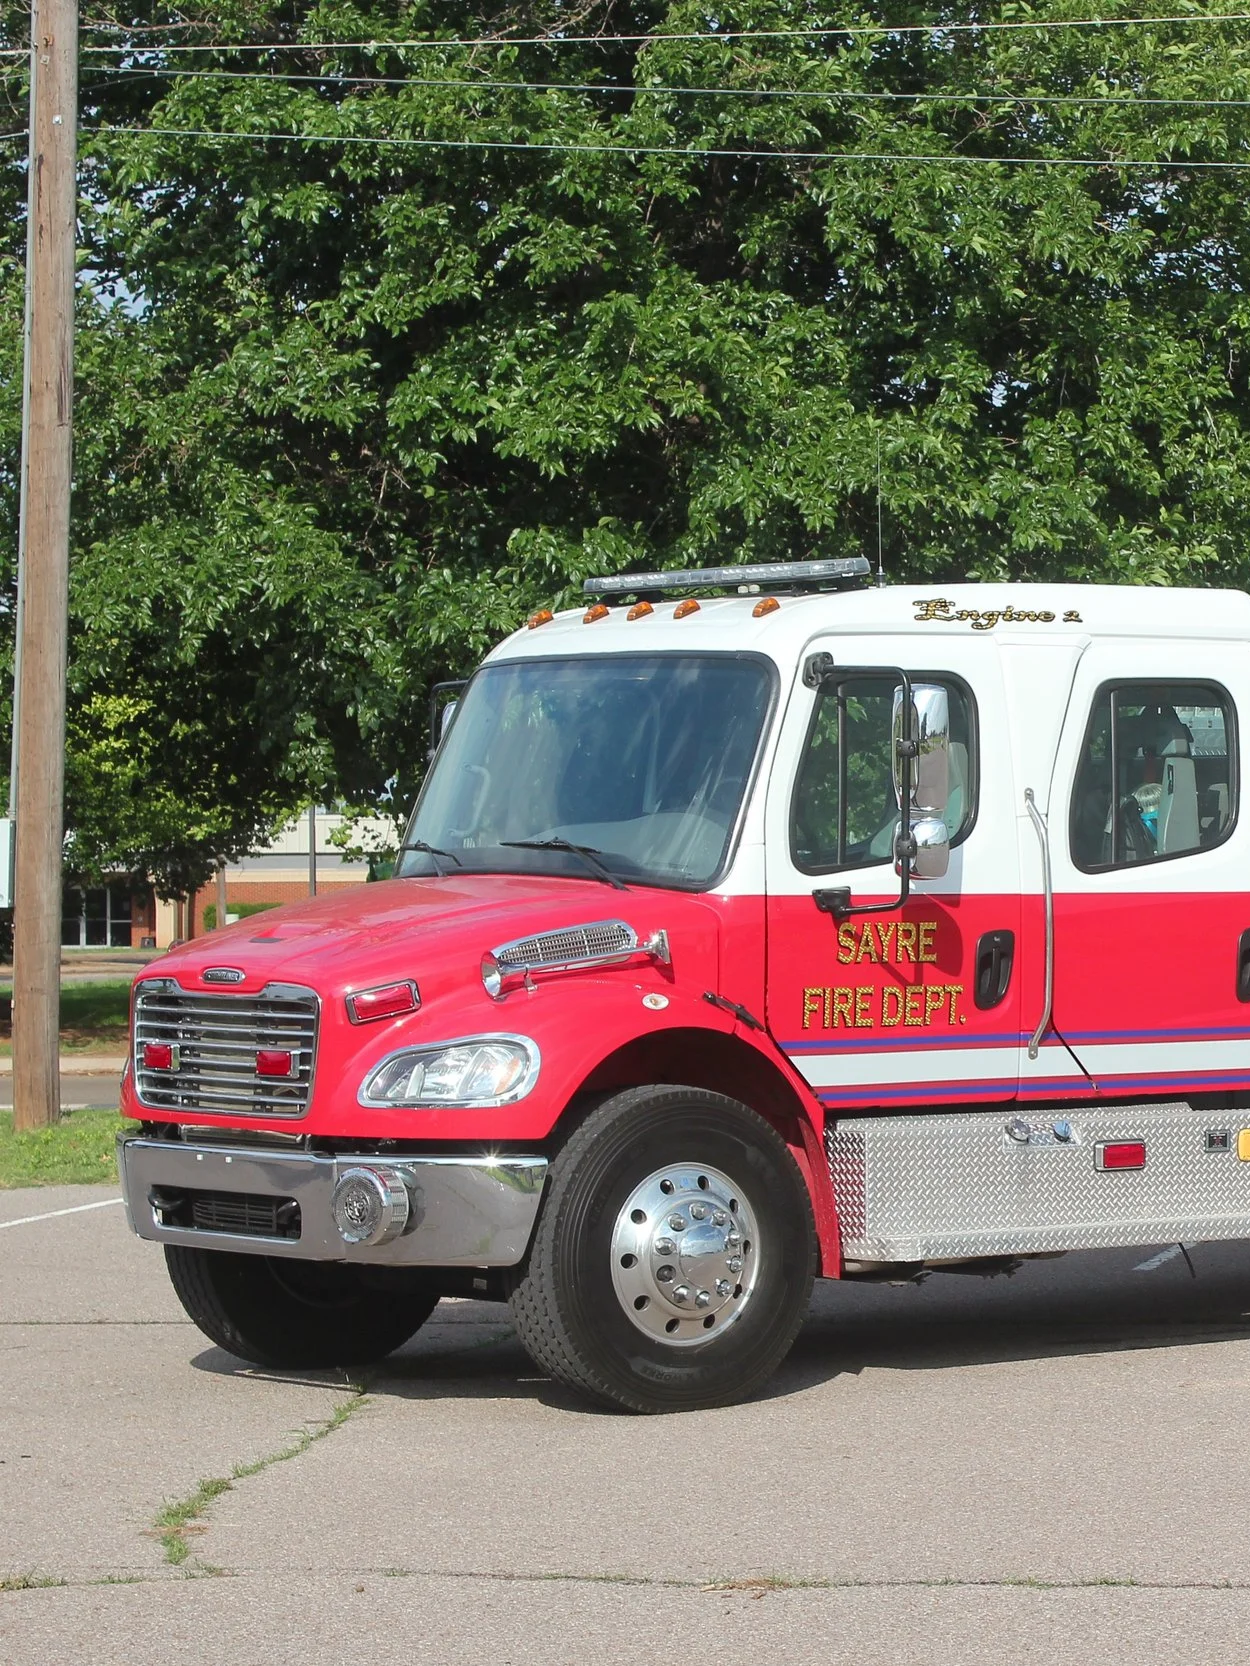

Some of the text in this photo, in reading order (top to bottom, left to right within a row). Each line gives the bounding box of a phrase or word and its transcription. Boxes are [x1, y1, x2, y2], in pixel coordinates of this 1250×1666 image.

[912, 597, 1083, 630] Engine 2
[836, 921, 937, 964] SAYRE
[802, 983, 967, 1029] FIRE DEPT.
